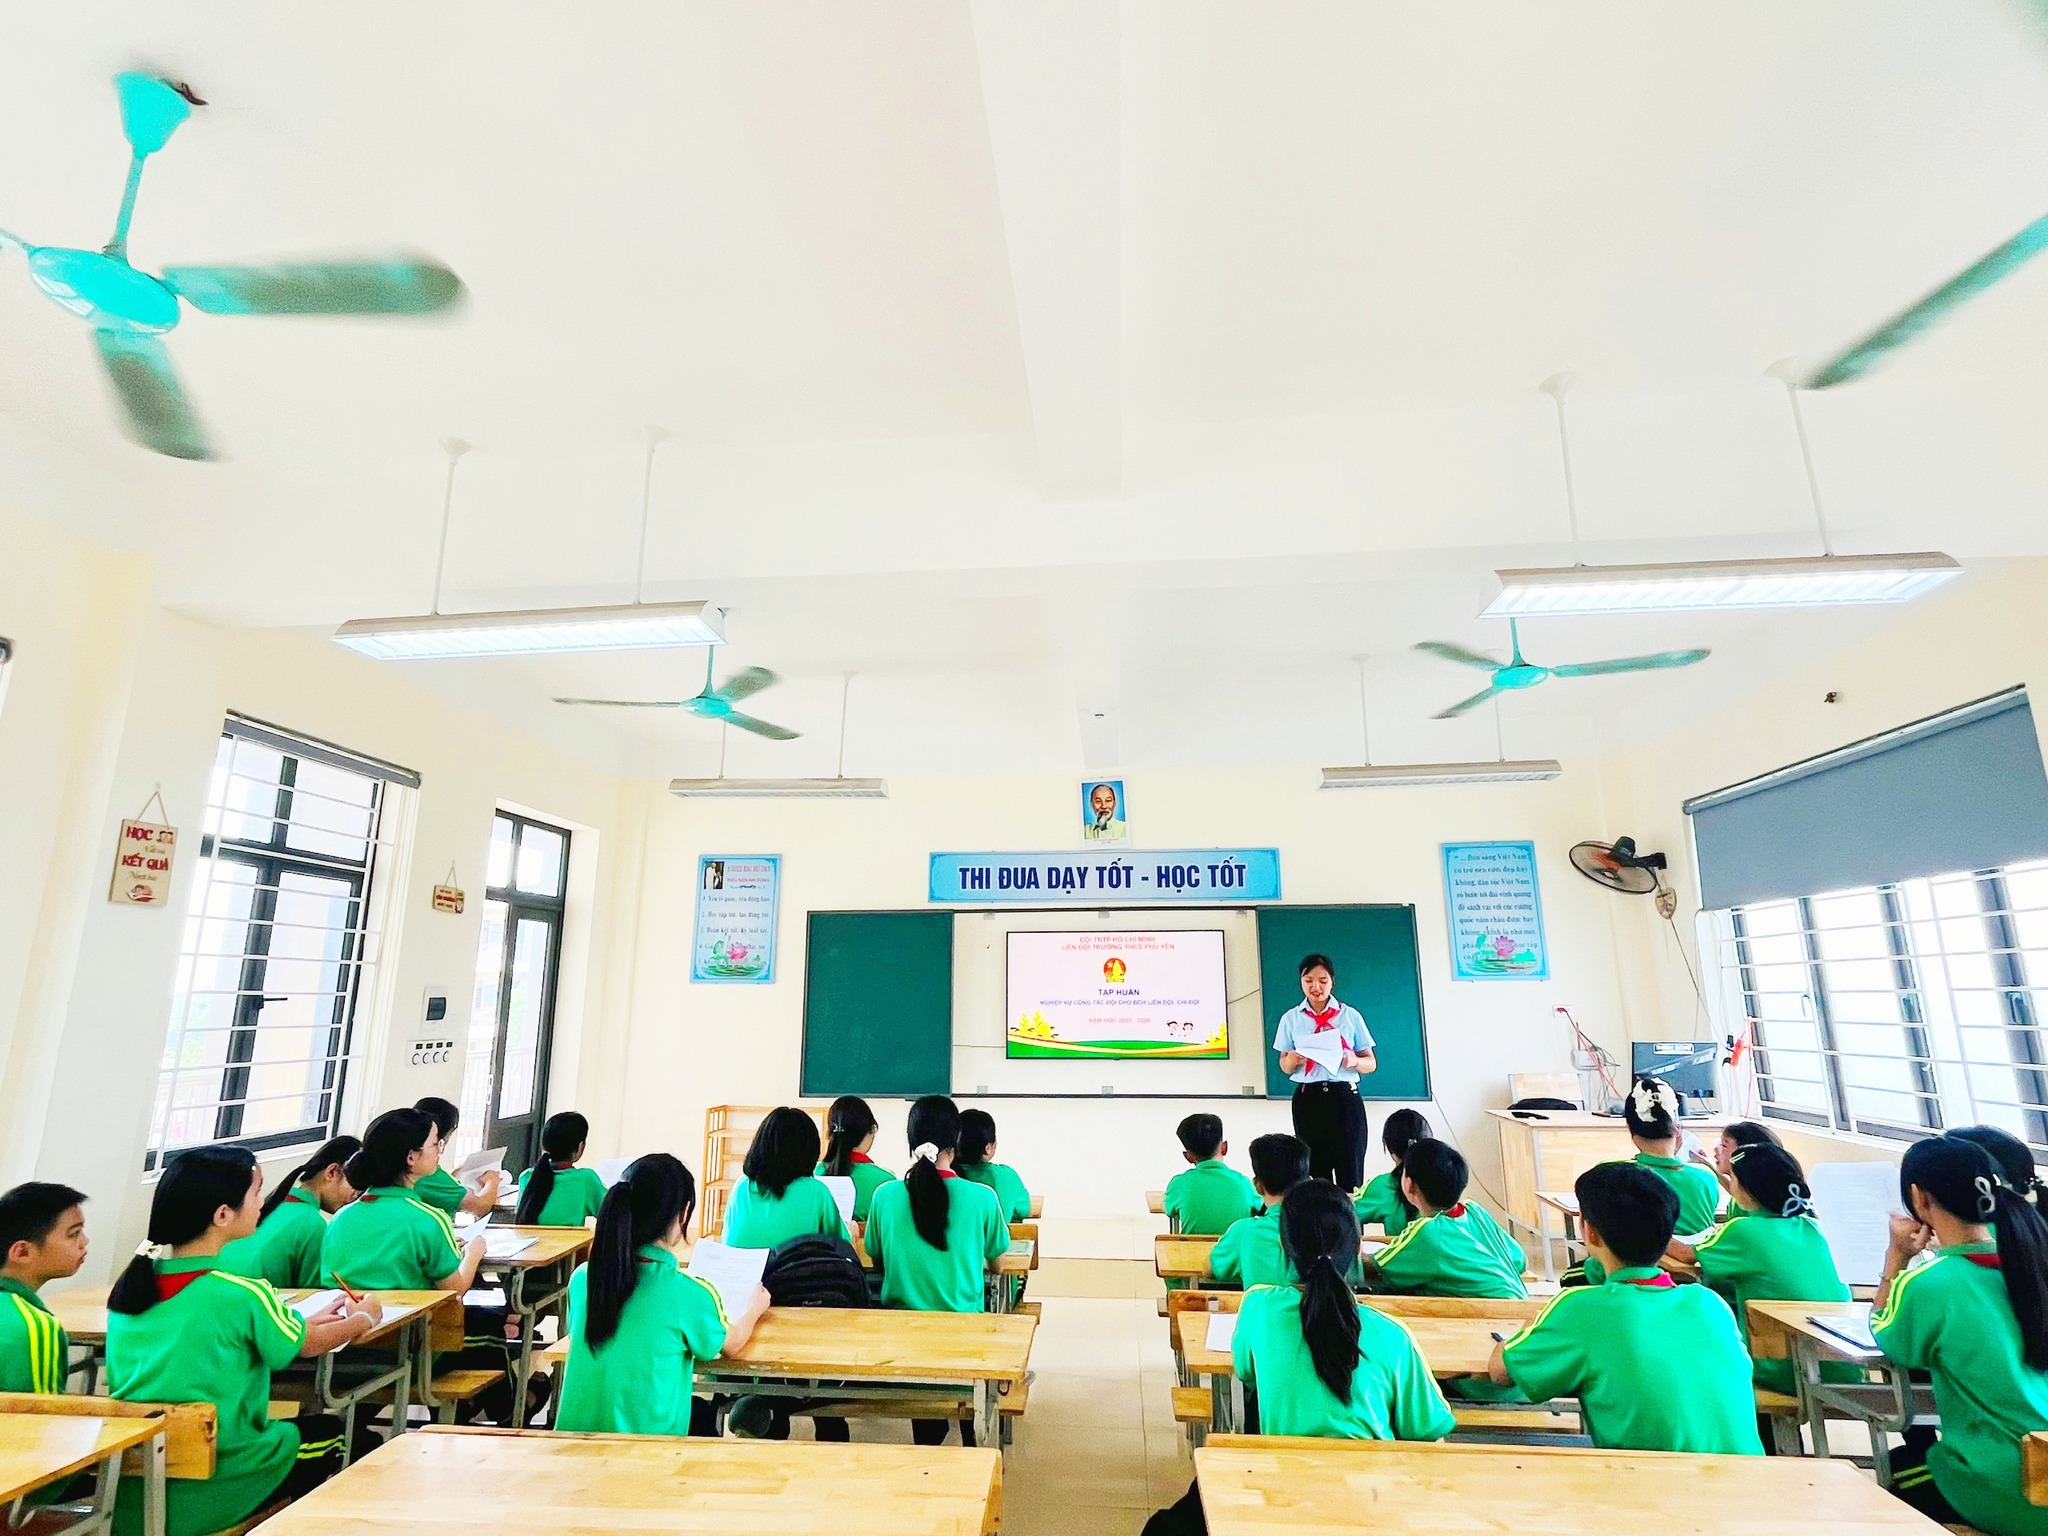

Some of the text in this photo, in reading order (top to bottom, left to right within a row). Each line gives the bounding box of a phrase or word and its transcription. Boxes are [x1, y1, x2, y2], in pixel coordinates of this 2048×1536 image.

[126, 826, 154, 841] HỌC
[122, 852, 168, 871] KẾT QUẢ
[959, 866, 990, 889] THI
[998, 867, 1040, 889] ĐUA
[1048, 867, 1088, 894] DẠY
[1096, 858, 1134, 889] TỐT
[1157, 865, 1200, 893] HỌC
[1208, 856, 1246, 888] TỐT
